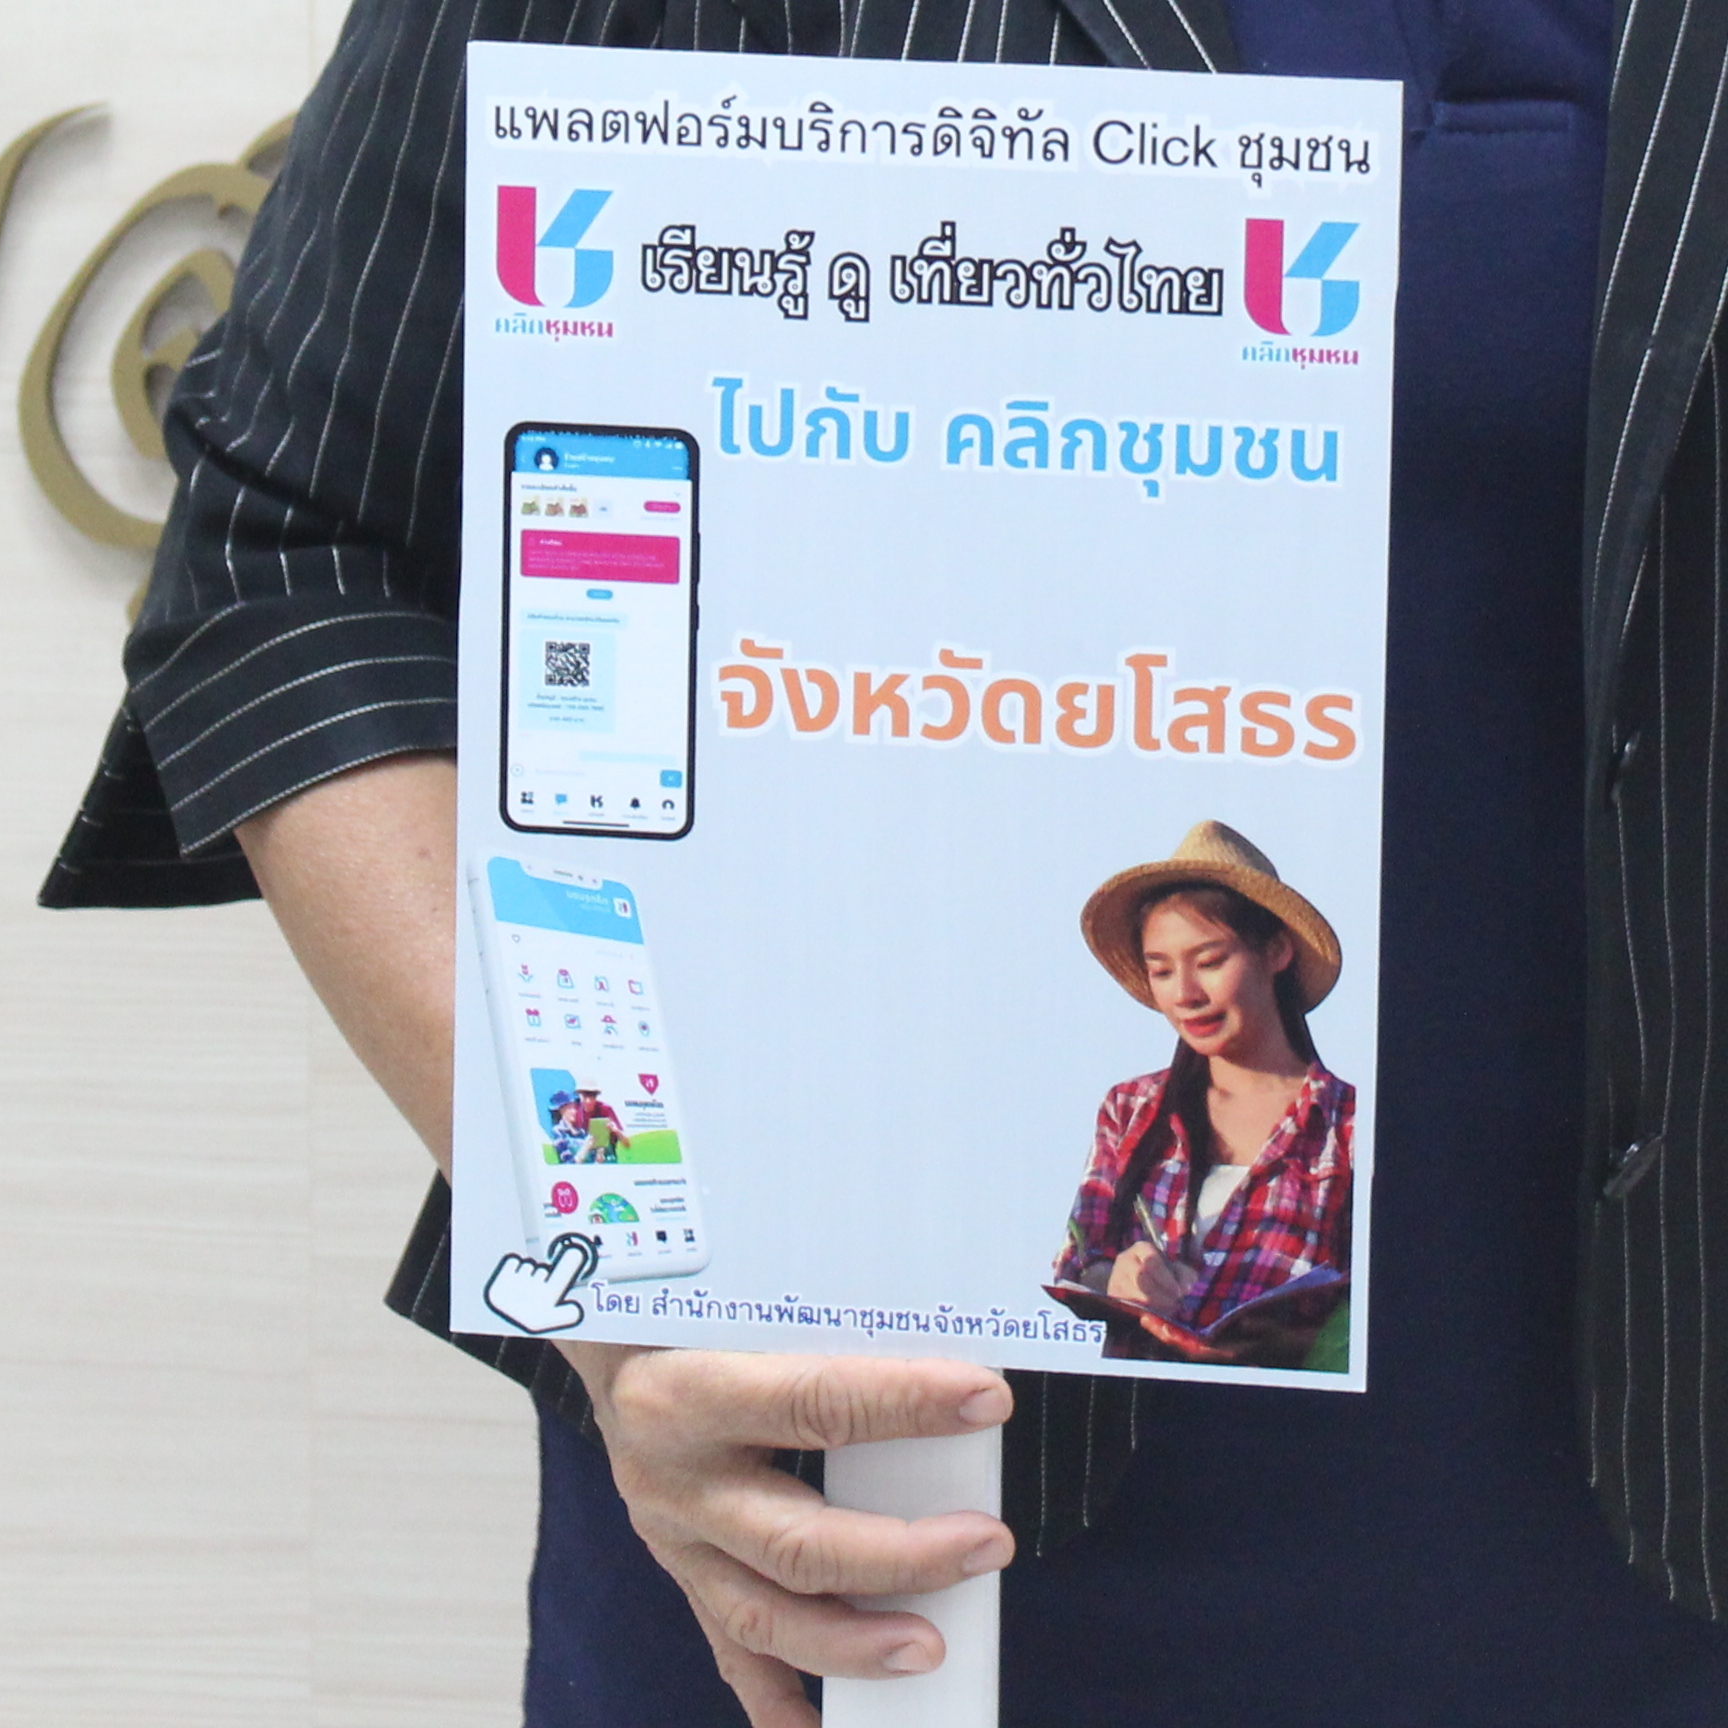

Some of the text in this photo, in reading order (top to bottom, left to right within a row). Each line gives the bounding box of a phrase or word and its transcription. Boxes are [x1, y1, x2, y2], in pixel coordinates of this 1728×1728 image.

[493, 94, 1371, 187] แพลตฟอร์มบริการดิจิทัล Click ชุมชน
[640, 221, 1225, 322] เรียนรู้ ดู เที่ยวทั่วไทย
[495, 314, 614, 341] คลิกชุมชน
[1241, 342, 1360, 369] คลิกชุมชน
[711, 377, 1341, 497] ไปกับ คลิกชุมชน
[717, 639, 1358, 760] จังหวัดยโสธร
[591, 1282, 1102, 1345] โดย สำนักงานพัฒนาชุมชนจังหวัดยโสธร
